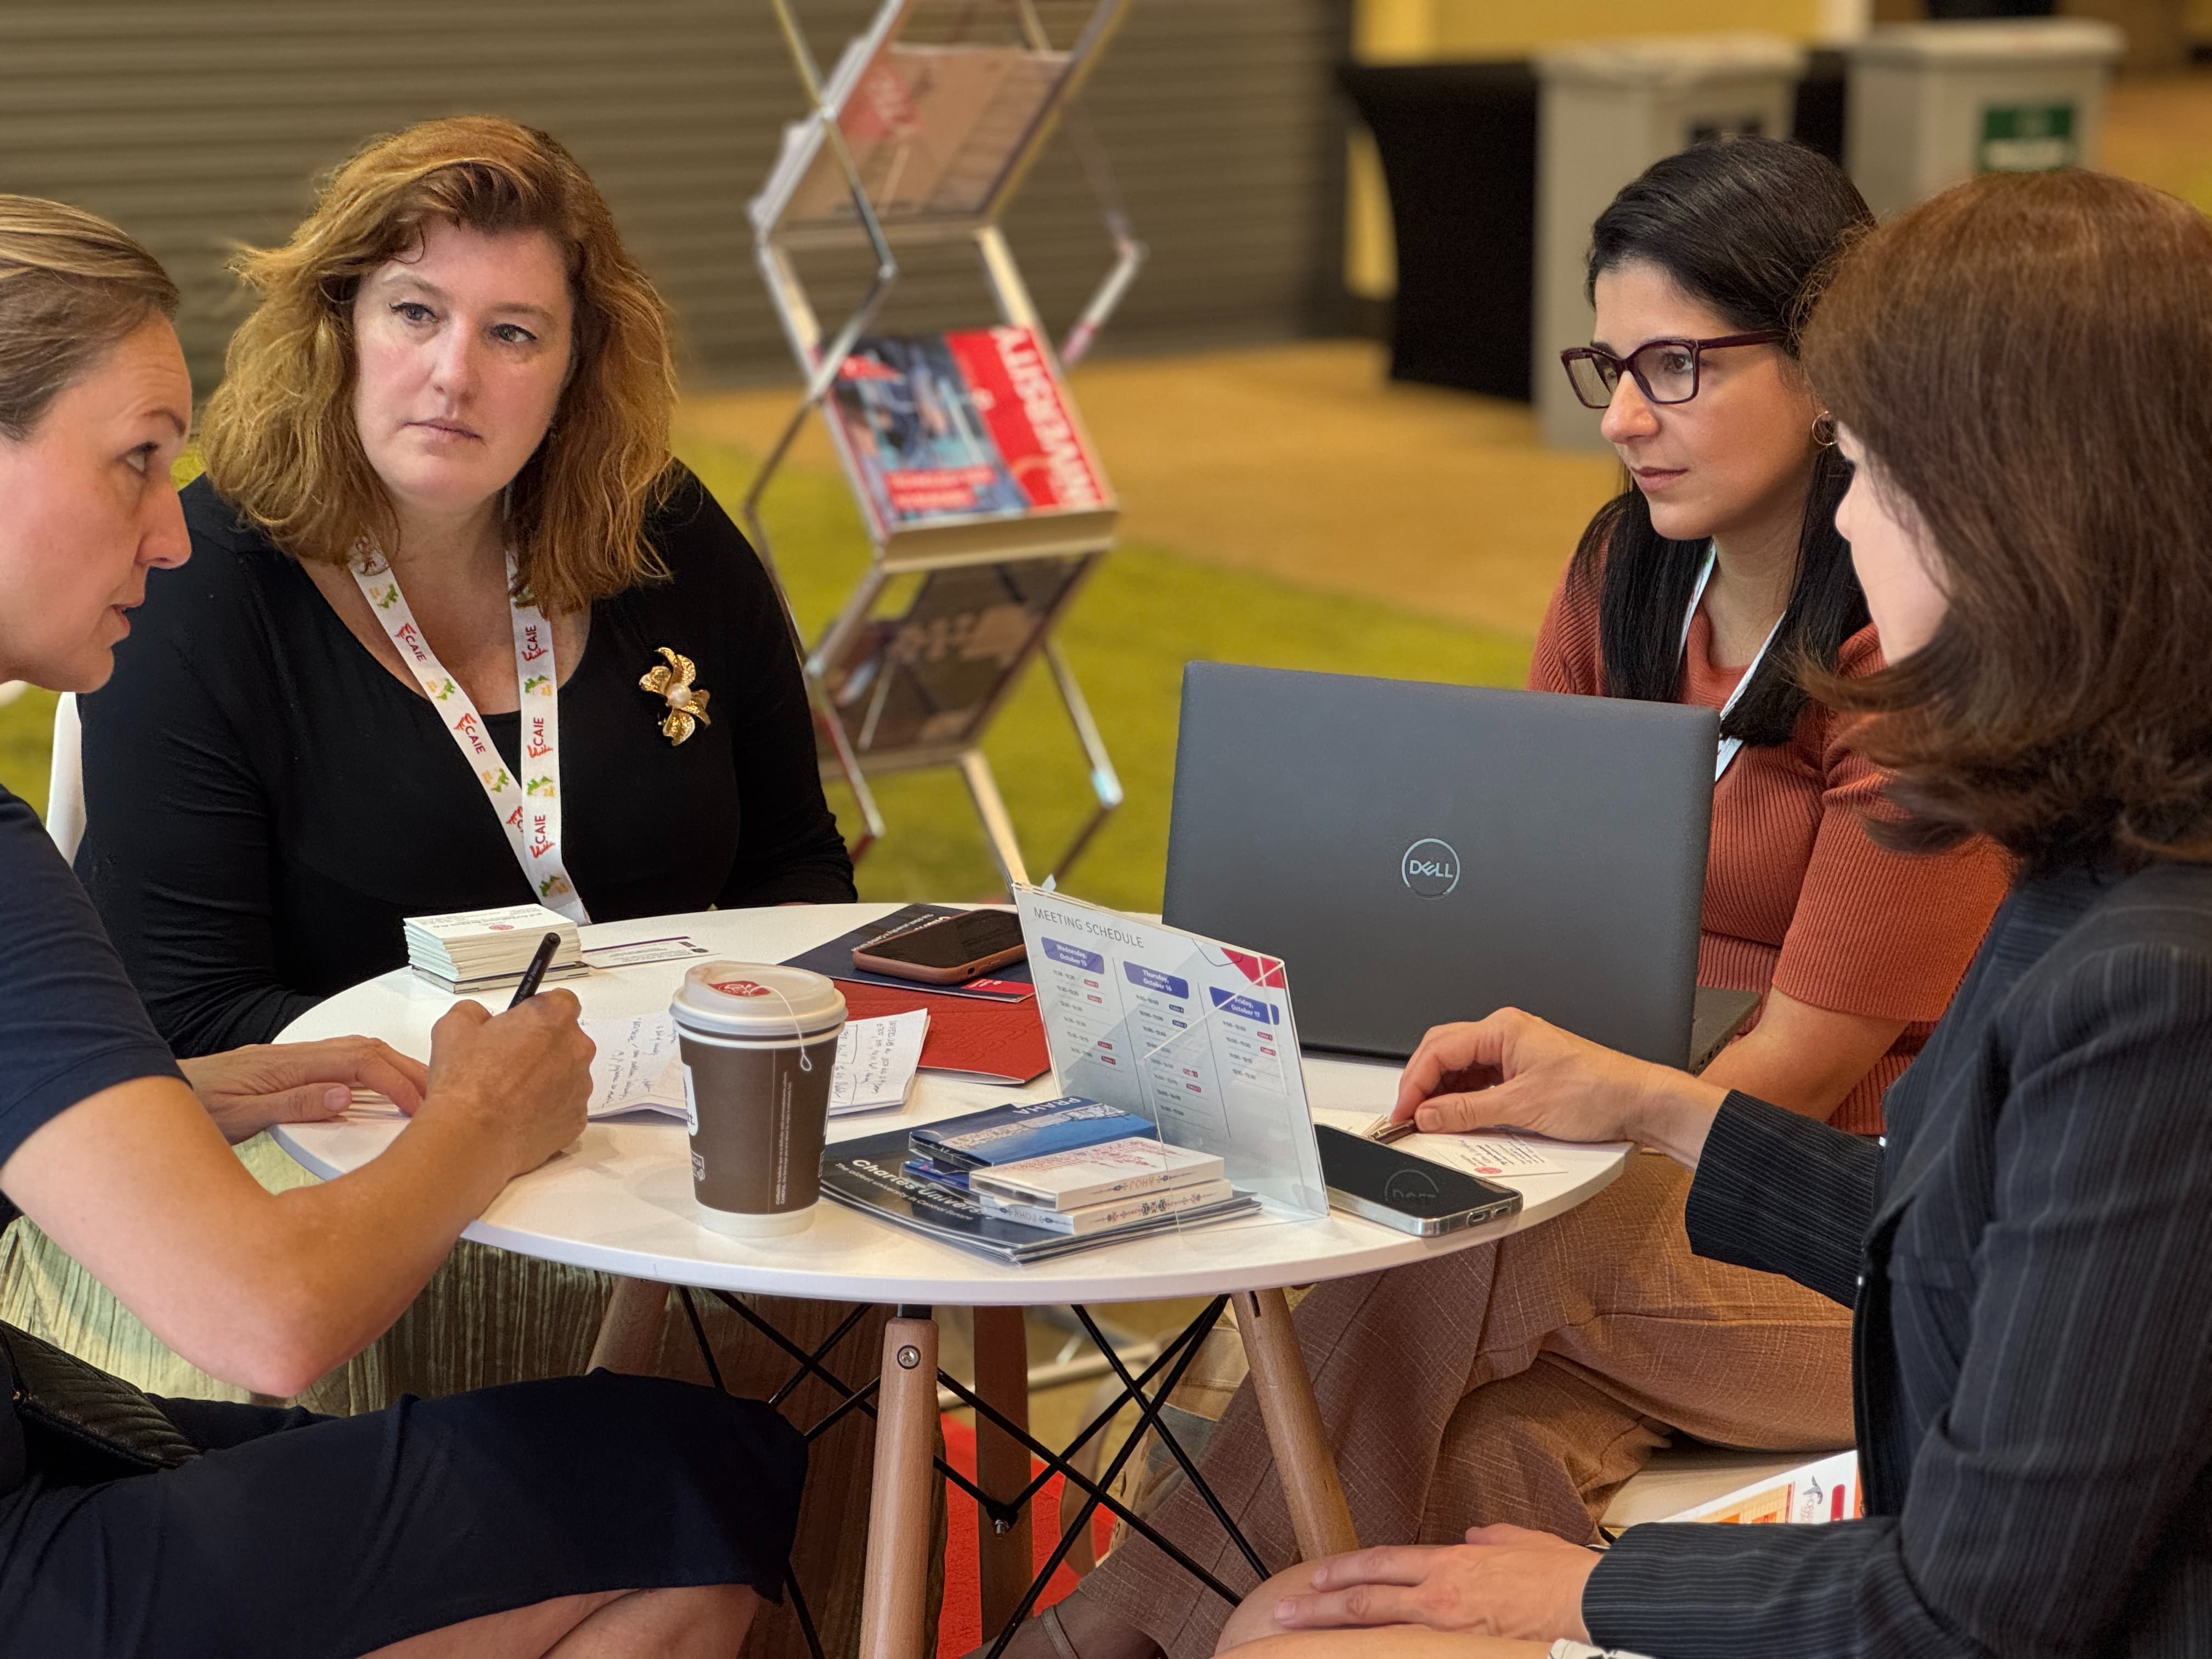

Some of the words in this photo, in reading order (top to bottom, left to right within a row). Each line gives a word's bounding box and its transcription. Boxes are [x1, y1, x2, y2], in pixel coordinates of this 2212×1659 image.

[1409, 860, 1453, 878] DELL
[1034, 907, 1083, 930] MEETING
[1086, 922, 1144, 949] SCHEDULE
[1056, 944, 1087, 960] Wednesday,
[1059, 953, 1080, 964] October
[1142, 969, 1169, 984] Thursday,
[1143, 978, 1164, 990] October
[1231, 1004, 1253, 1016] October
[1234, 997, 1254, 1008] Friday,
[1012, 1097, 1082, 1114] PRAHA
[852, 1159, 916, 1190] Charles
[918, 1188, 983, 1215] Univers
[1128, 1176, 1154, 1191] AHOJ
[835, 1163, 849, 1171] The
[849, 1170, 874, 1183] oldest
[872, 1181, 909, 1198] university
[917, 1199, 946, 1214] Central
[945, 1210, 974, 1221] Europe
[1014, 1210, 1037, 1223] AHOJ
